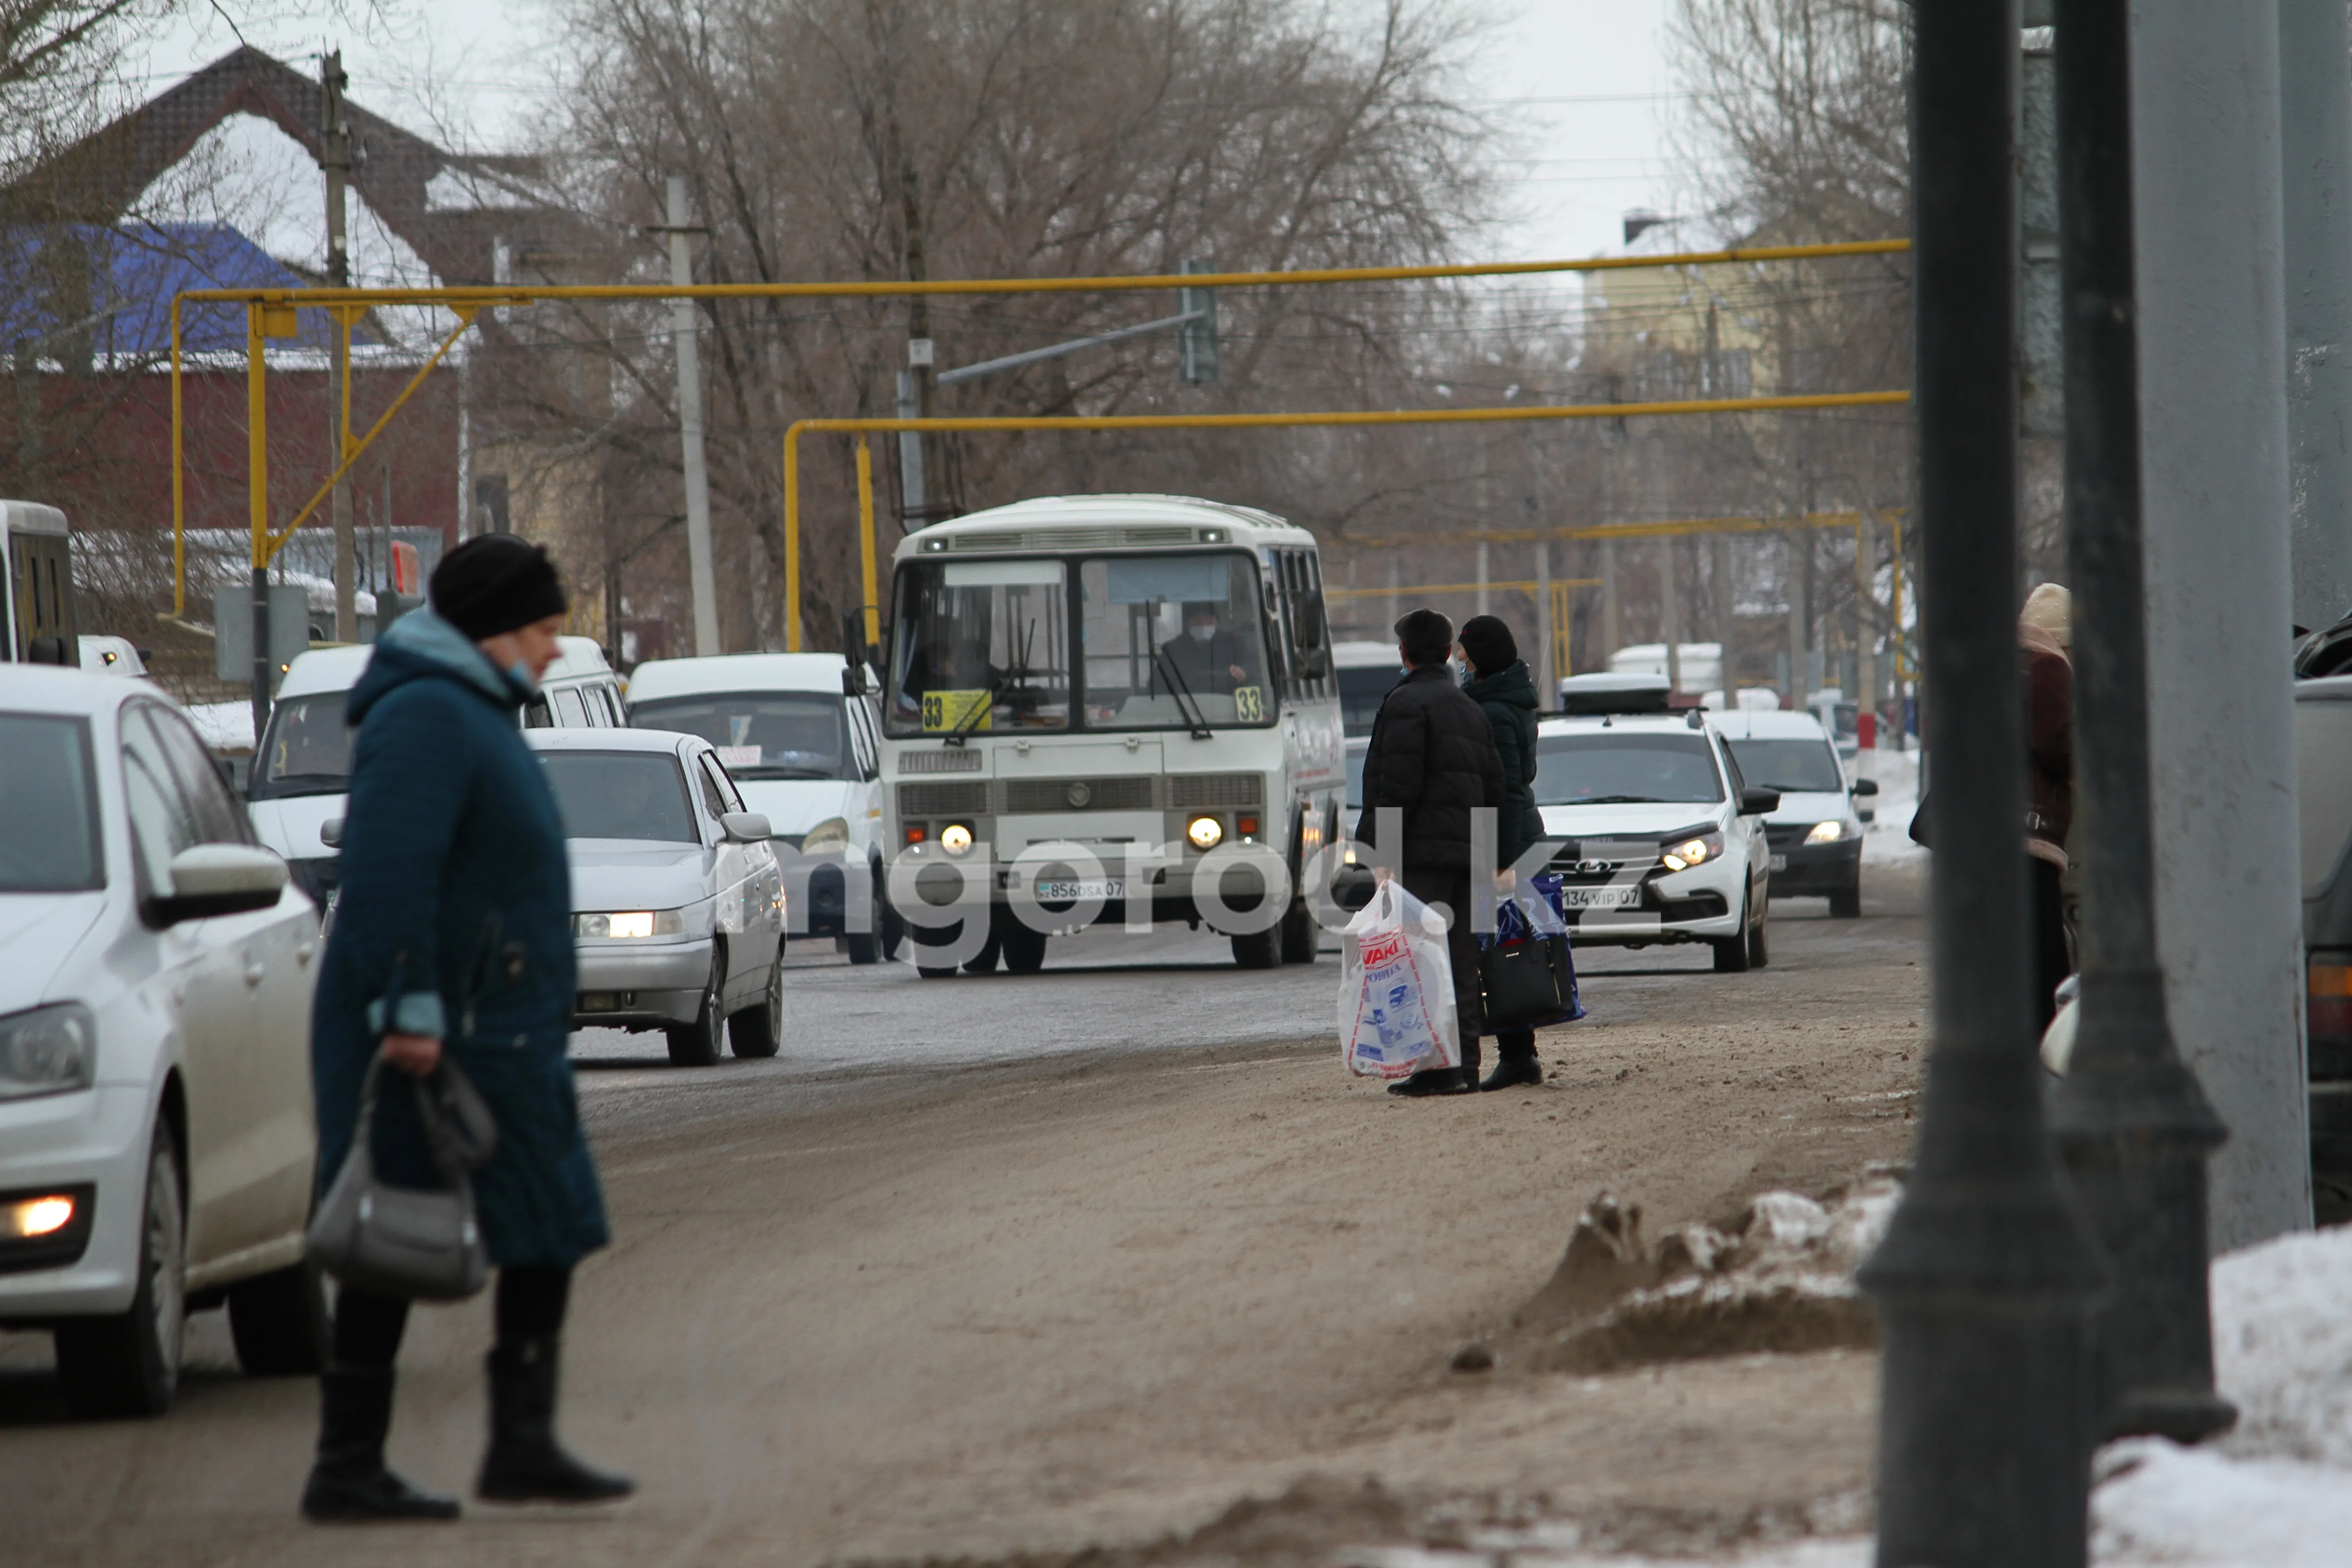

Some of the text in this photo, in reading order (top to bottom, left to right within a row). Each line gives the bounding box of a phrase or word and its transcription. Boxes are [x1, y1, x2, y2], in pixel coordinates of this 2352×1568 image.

[925, 696, 942, 727] 33
[1238, 690, 1260, 720] 33
[1106, 882, 1122, 896] 07
[1563, 889, 1639, 906] 134 VIP 07
